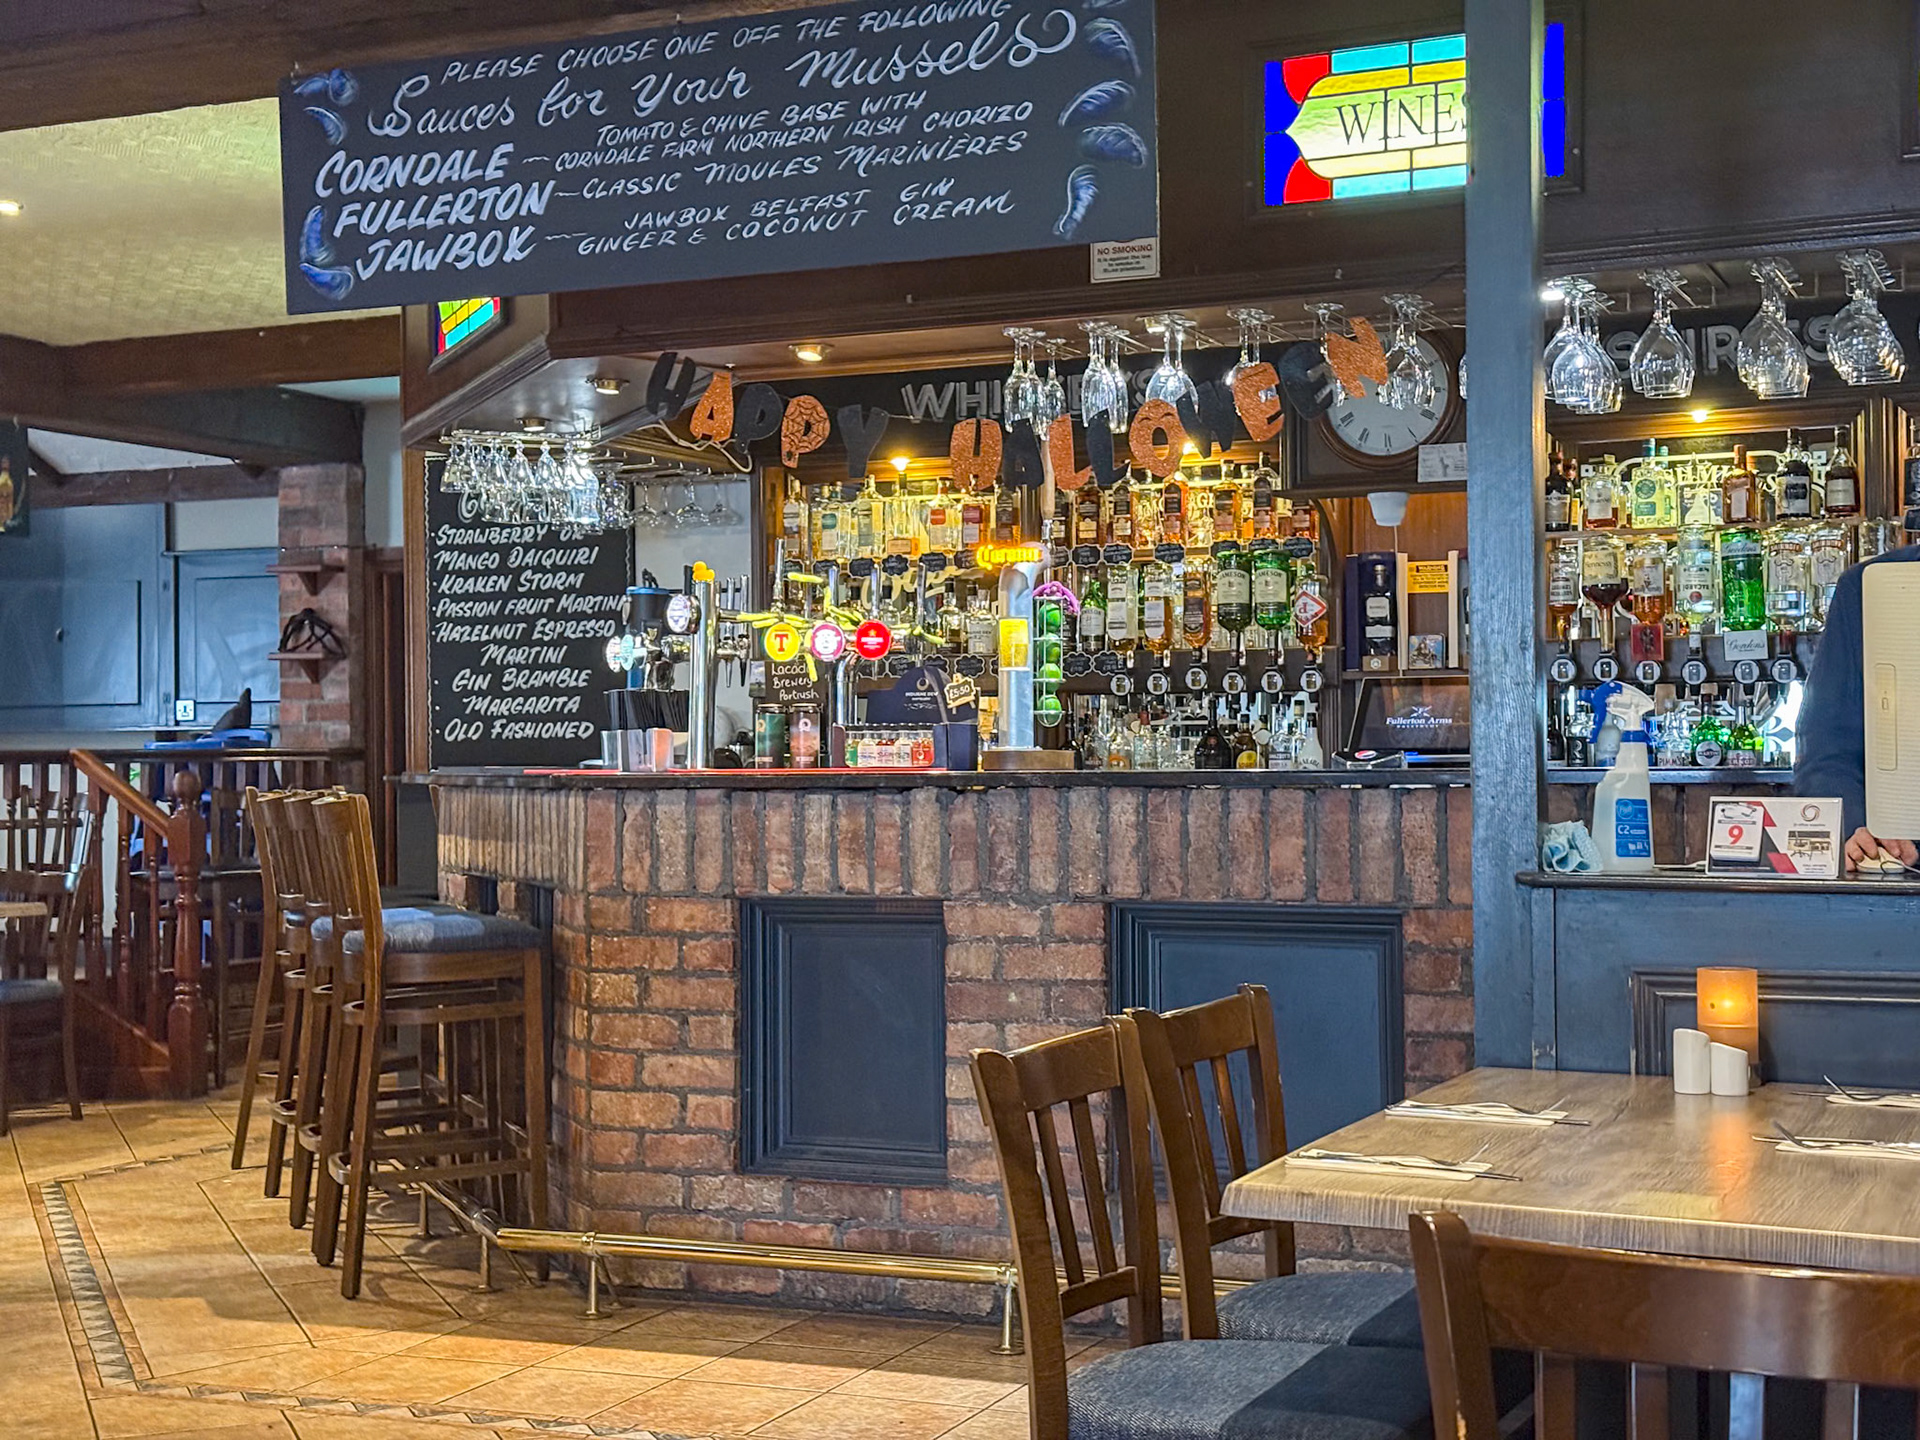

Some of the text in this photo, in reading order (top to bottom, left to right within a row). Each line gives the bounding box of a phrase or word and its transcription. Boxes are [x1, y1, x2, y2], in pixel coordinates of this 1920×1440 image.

[440, 53, 544, 86] PLEASE
[557, 38, 659, 73] CHOOSE
[665, 30, 719, 61] ONE
[797, 16, 848, 42] THE
[858, 0, 1012, 32] FOLLOWING
[367, 9, 1077, 137] Sauces for Your Mussels
[596, 89, 927, 148] TOMATO & CHIVE BASE WITH
[315, 101, 1034, 198] CORNDALE CORNDALE FARM NORTHERN IRISH CHORIZO
[332, 179, 557, 239] FULLERTON
[581, 171, 682, 200] CLASSIC
[693, 156, 823, 186] MOULES
[624, 177, 955, 231] JAWBOX BELFAST GIN
[355, 225, 536, 282] JAWBOX
[577, 229, 677, 256] GINGER
[725, 209, 869, 241] COCONUT
[893, 191, 1016, 226] CREAM
[1097, 244, 1153, 256] NO SMOKING
[646, 351, 889, 479] HAPPY
[949, 316, 1388, 492] HALLOWEEN
[436, 523, 548, 546] STRAWBERRY
[434, 546, 599, 571] MANGO DAIQUIRI
[438, 568, 585, 595] KRAKEN STORM
[436, 597, 499, 619] PASSION
[504, 596, 555, 615] FRUIT
[435, 618, 616, 643] HAZELNUT ESPRESSO
[481, 643, 567, 667] MARTINI
[452, 668, 592, 693] GIN BRAMBLE
[772, 676, 813, 689] Brewery
[462, 694, 582, 716] MARGARITA
[779, 688, 819, 701] Portrush
[444, 718, 595, 742] OLD FASHIONED
[1386, 716, 1453, 725] Fullerton Arms
[1617, 825, 1630, 835] C2
[1728, 825, 1744, 845] 9
